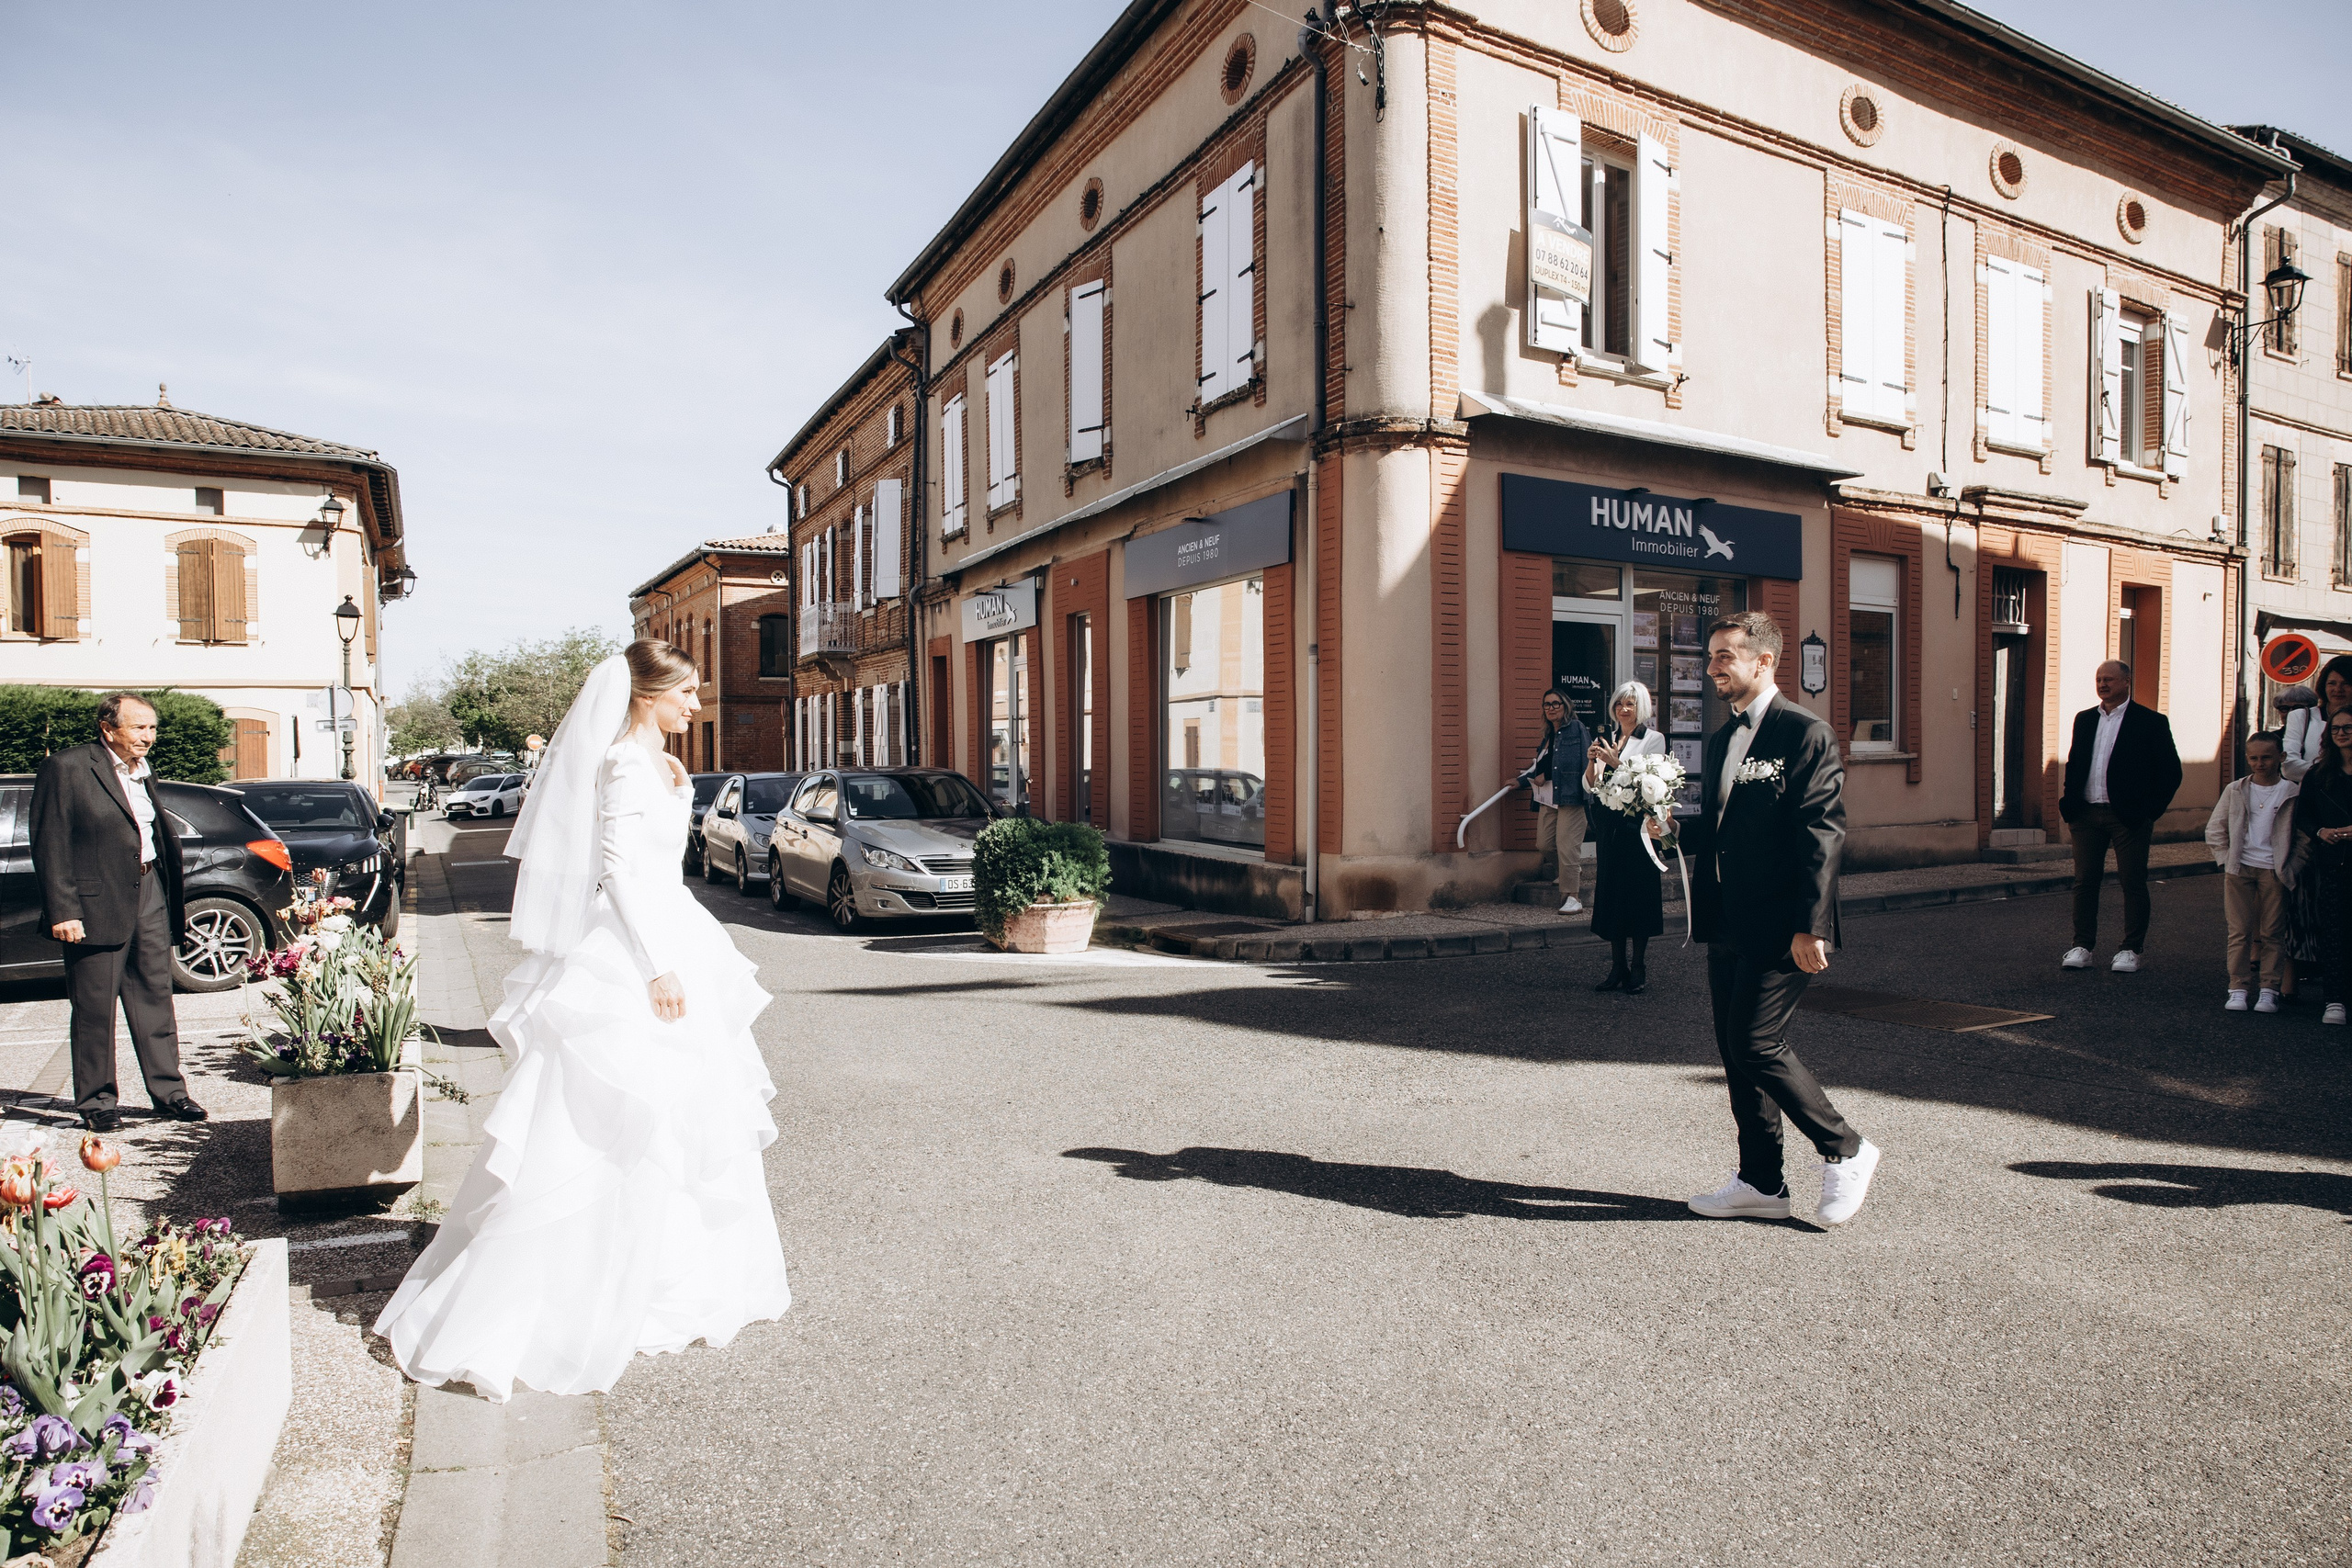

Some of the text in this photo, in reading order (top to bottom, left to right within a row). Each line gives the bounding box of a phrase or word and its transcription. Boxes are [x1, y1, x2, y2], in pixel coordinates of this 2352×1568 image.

[1548, 234, 1589, 263] VENDRE
[1536, 248, 1588, 280] 07 88 62 20 64
[1535, 265, 1559, 281] DUPLEX
[1560, 274, 1567, 284] T4
[1571, 280, 1581, 291] 150
[1591, 496, 1692, 538] HUMAN
[1178, 534, 1220, 555] ANCIEN & NEUF
[1632, 537, 1698, 558] Immobilier
[1178, 548, 1219, 567] DEPUIS 1980
[975, 594, 1004, 620] HUMAN
[1659, 591, 1720, 604] ANCIEN & NEUF
[1660, 602, 1719, 616] DEPUIS 1980
[1561, 675, 1589, 684] HUMAN
